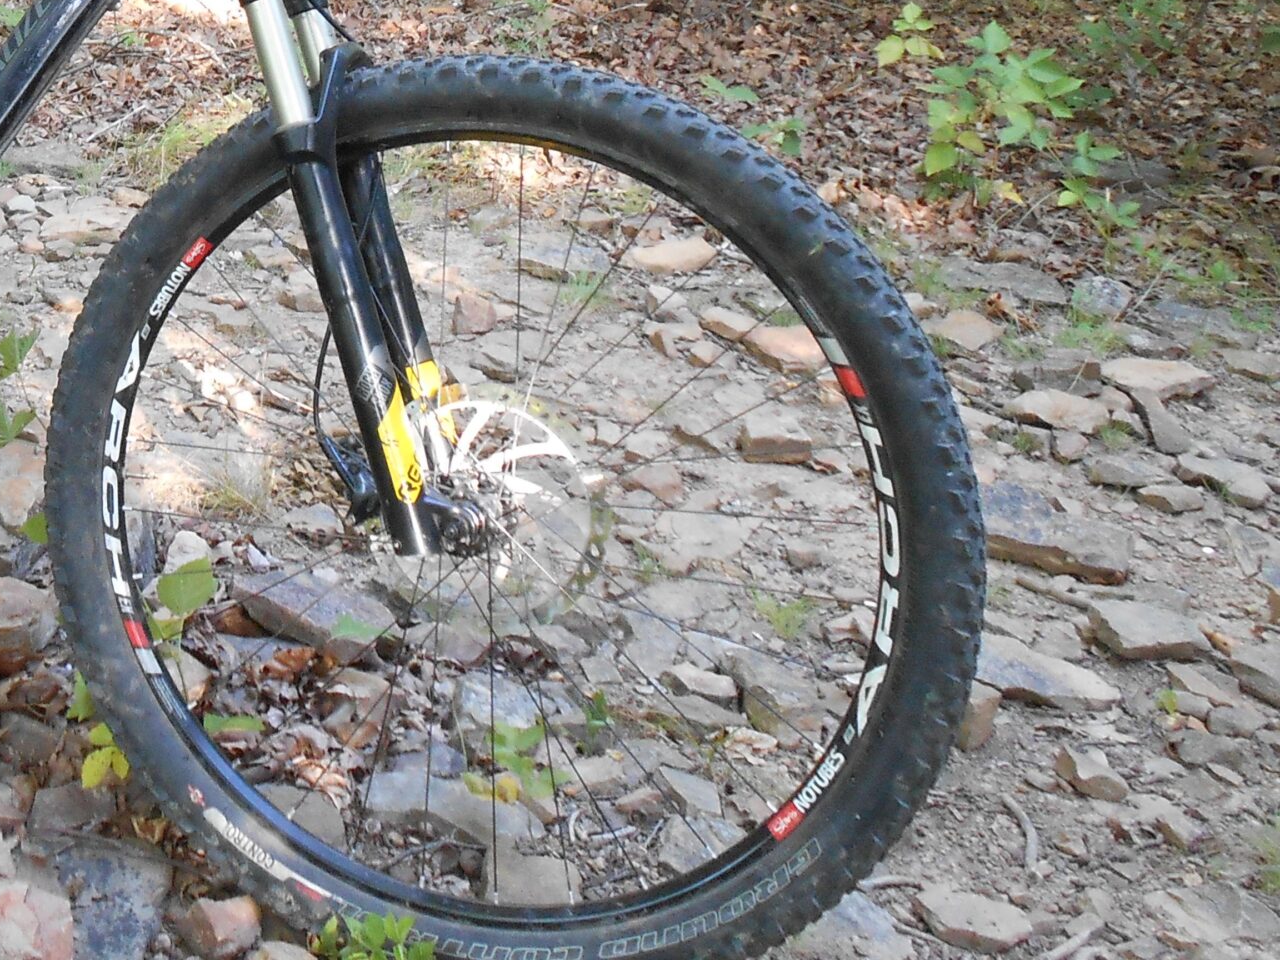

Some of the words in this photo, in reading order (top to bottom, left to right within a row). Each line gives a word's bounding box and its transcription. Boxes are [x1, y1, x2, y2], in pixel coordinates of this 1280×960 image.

[149, 261, 193, 320] NOTUBES
[102, 329, 141, 597] ARCH
[856, 421, 902, 739] ARCH
[792, 744, 846, 814] NOTUBES
